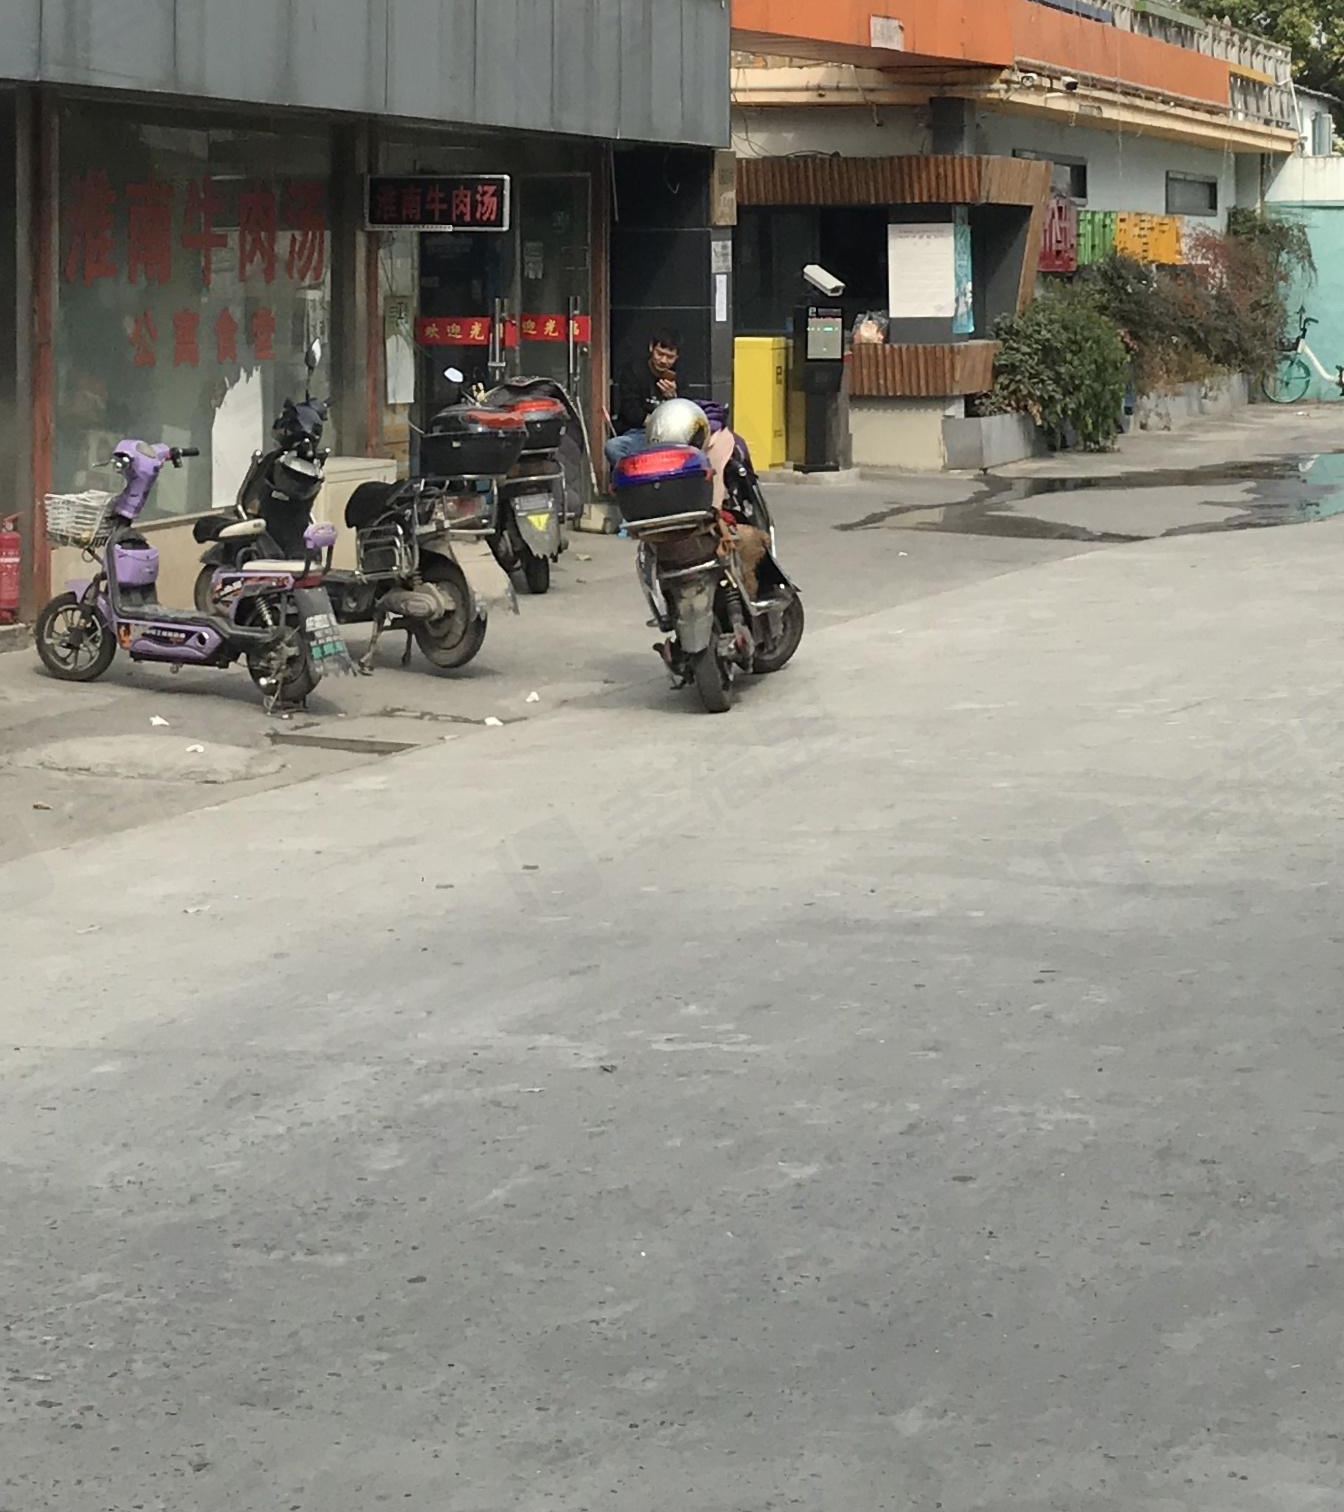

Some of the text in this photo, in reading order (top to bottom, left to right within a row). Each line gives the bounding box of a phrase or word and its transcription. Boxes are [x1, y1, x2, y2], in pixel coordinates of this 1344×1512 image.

[378, 184, 498, 222] 淮南牛肉汤
[62, 168, 325, 288] 淮南牛肉汤
[128, 308, 276, 368] 公寓食堂
[424, 321, 504, 341] 欢迎光
